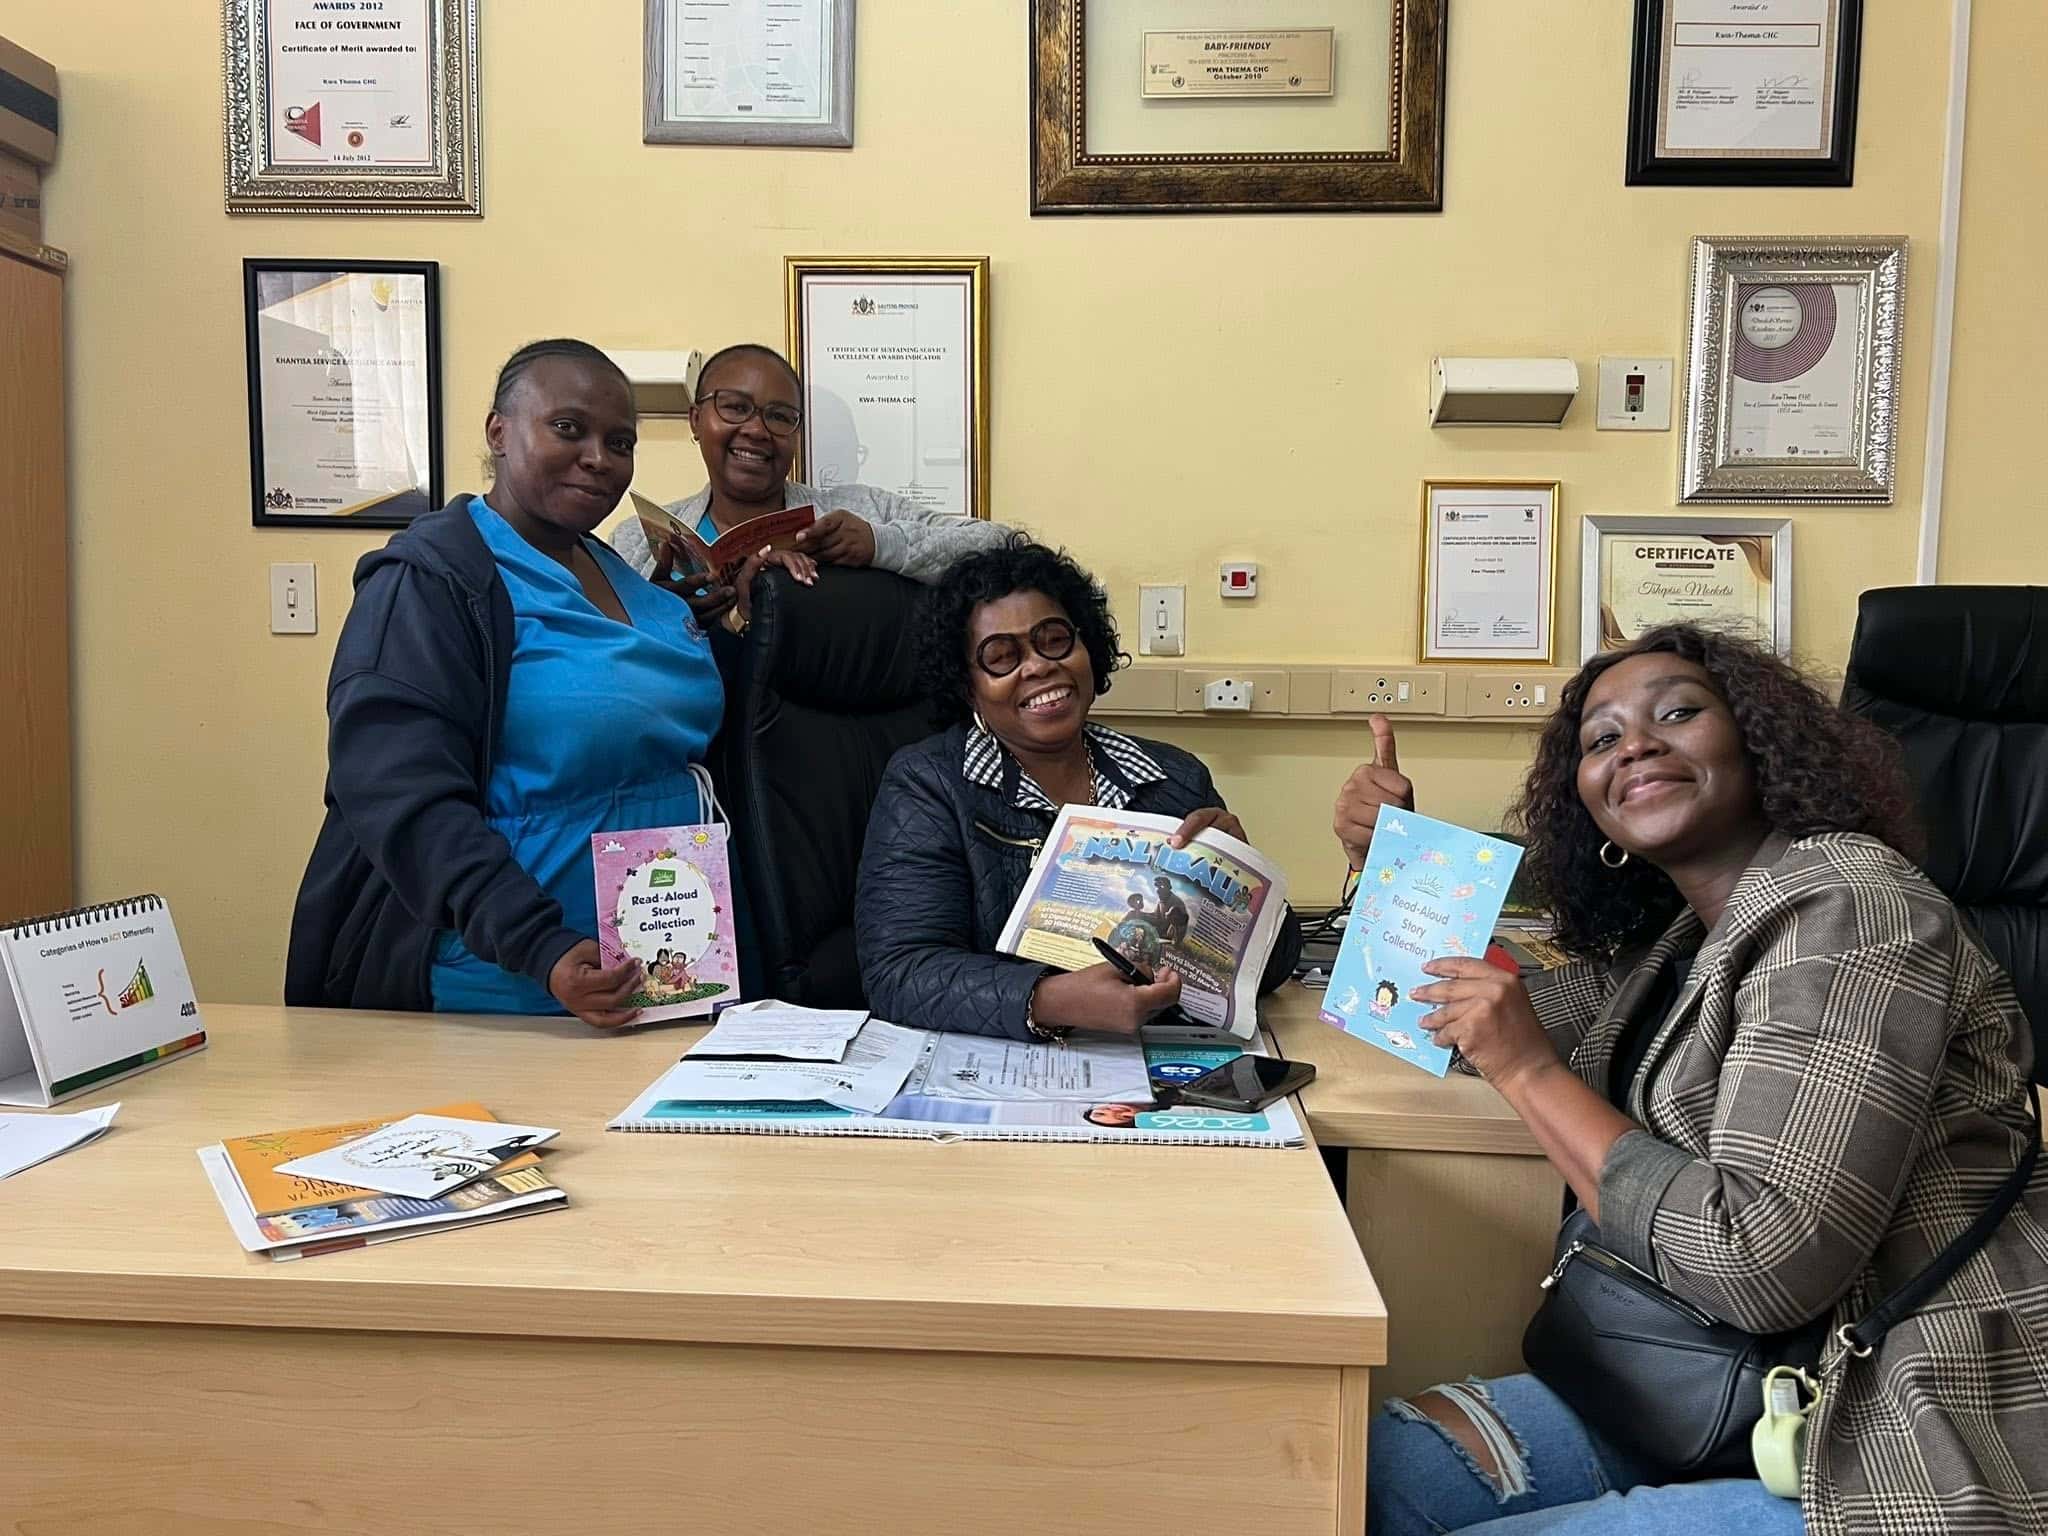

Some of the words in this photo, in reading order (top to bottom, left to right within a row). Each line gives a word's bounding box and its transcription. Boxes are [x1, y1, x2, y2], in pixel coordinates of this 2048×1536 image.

[312, 2, 356, 11] AWARDS
[359, 2, 384, 11] 2012
[295, 21, 317, 30] FACE
[320, 21, 333, 30] OF
[336, 21, 402, 30] GOVERNMENT
[281, 45, 328, 53] Certificate
[329, 45, 339, 53] of
[341, 45, 364, 53] Merit
[366, 45, 404, 53] awarded
[1204, 42, 1271, 50] BABY-FRIENDLY
[1635, 547, 1735, 561] CERTIFICATE
[631, 889, 698, 906] Read-Aloud
[651, 905, 680, 917] Story
[1392, 894, 1450, 926] Read-Aloud
[639, 918, 695, 932] Collection
[1401, 918, 1426, 940] Story
[40, 943, 77, 958] Categories
[78, 941, 85, 950] of
[85, 938, 101, 948] How
[101, 936, 109, 944] to
[122, 927, 154, 940] Differently
[664, 932, 673, 943] 2
[1382, 931, 1428, 959] Collection
[1150, 1113, 1255, 1130] 2026
